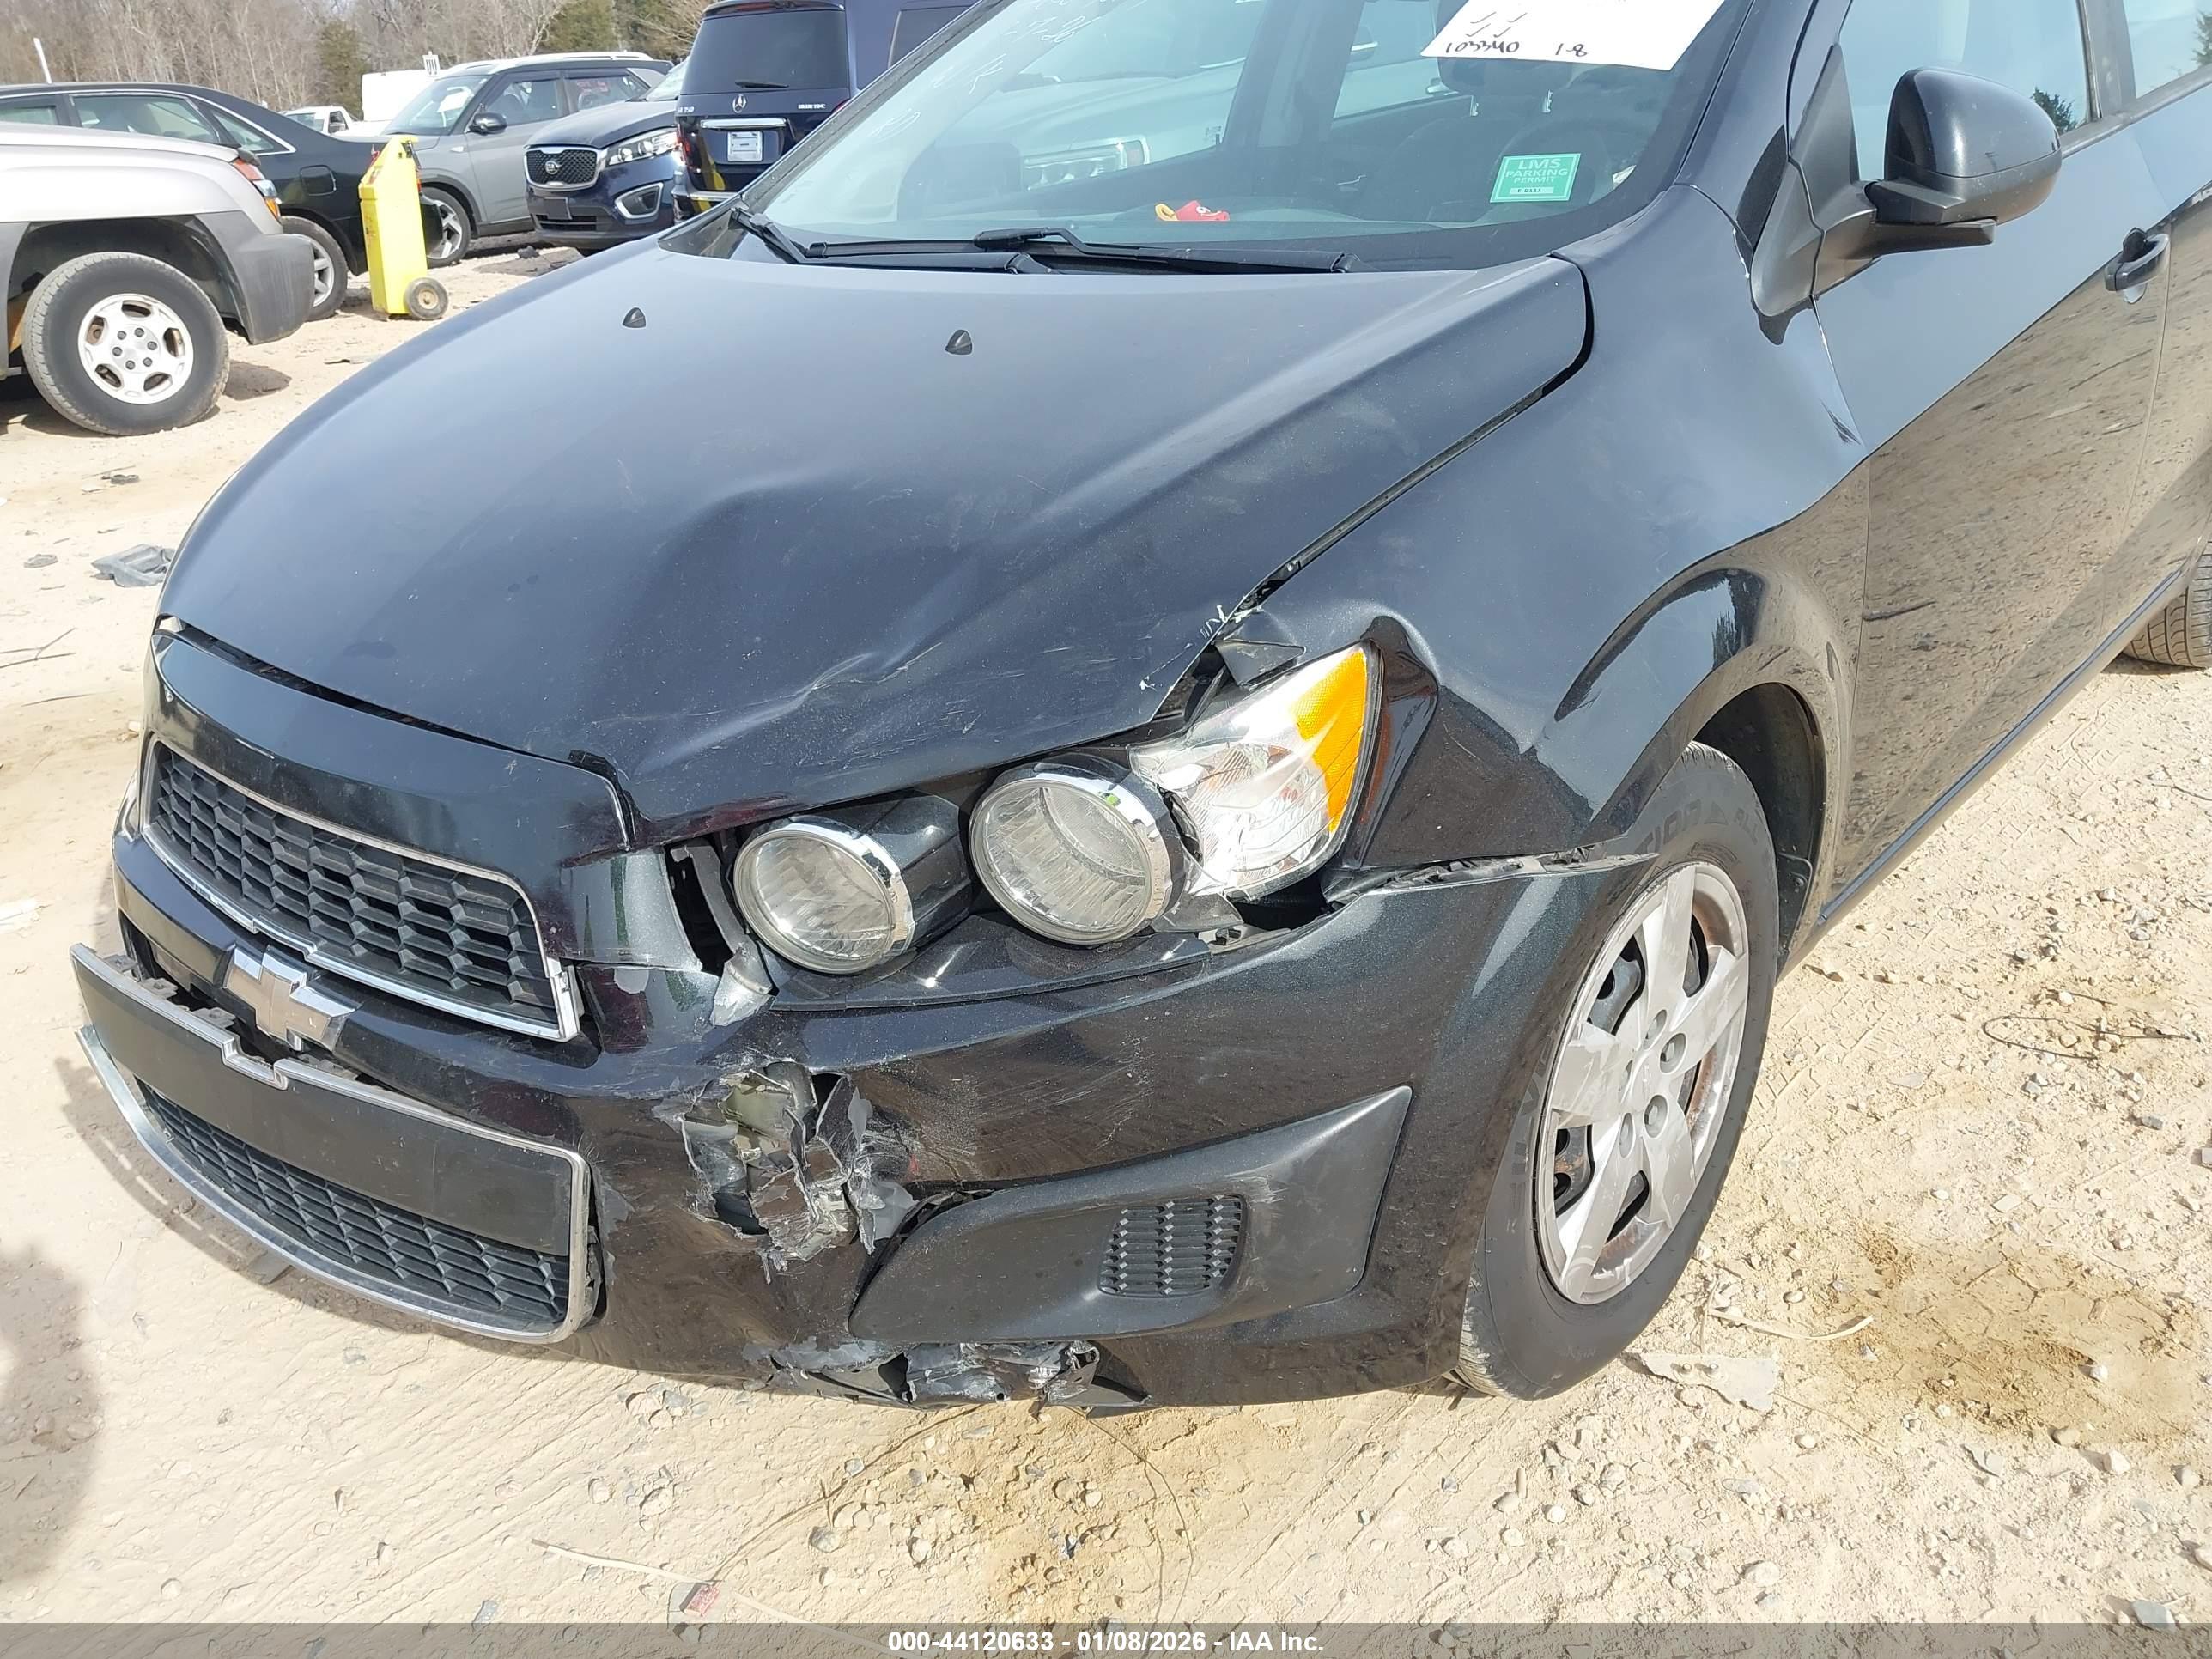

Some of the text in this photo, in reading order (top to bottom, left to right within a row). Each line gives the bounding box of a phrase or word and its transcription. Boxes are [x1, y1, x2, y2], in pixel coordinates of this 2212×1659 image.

[1555, 43, 1588, 58] 1-8
[1518, 159, 1561, 170] LMS
[1505, 168, 1568, 178] PARKING
